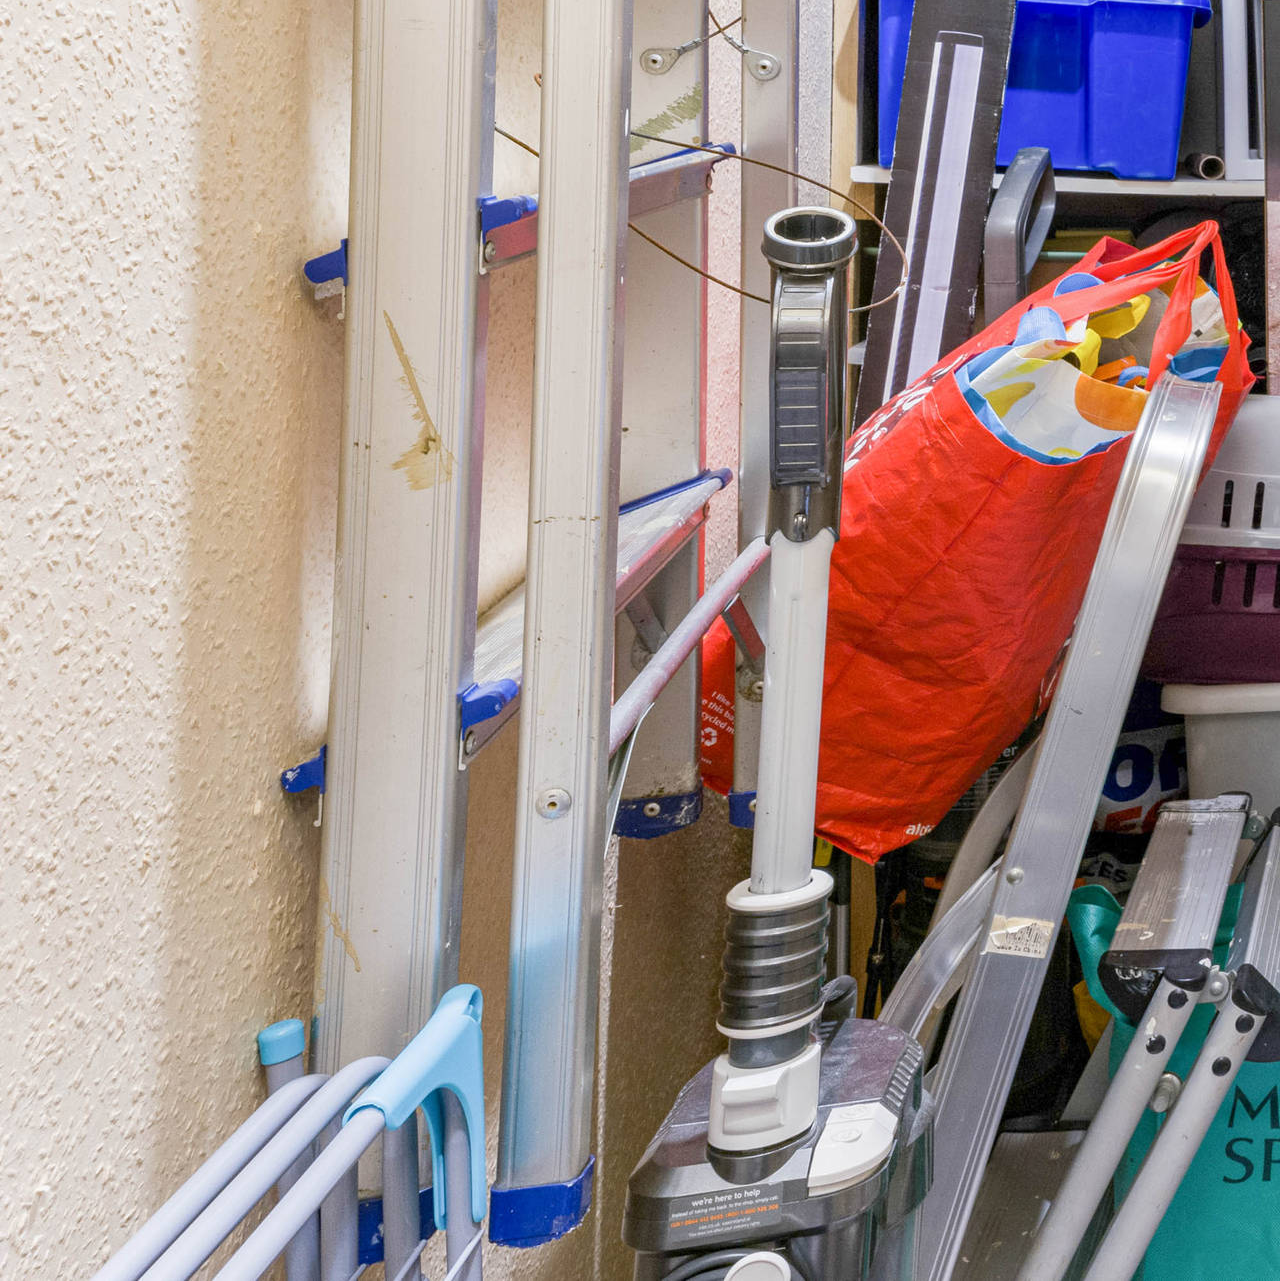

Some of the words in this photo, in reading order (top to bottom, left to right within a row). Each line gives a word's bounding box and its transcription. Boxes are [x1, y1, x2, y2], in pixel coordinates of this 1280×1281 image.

[692, 1197, 713, 1207] we're
[714, 1194, 733, 1204] here
[733, 1192, 743, 1200] to
[743, 1189, 761, 1198] help
